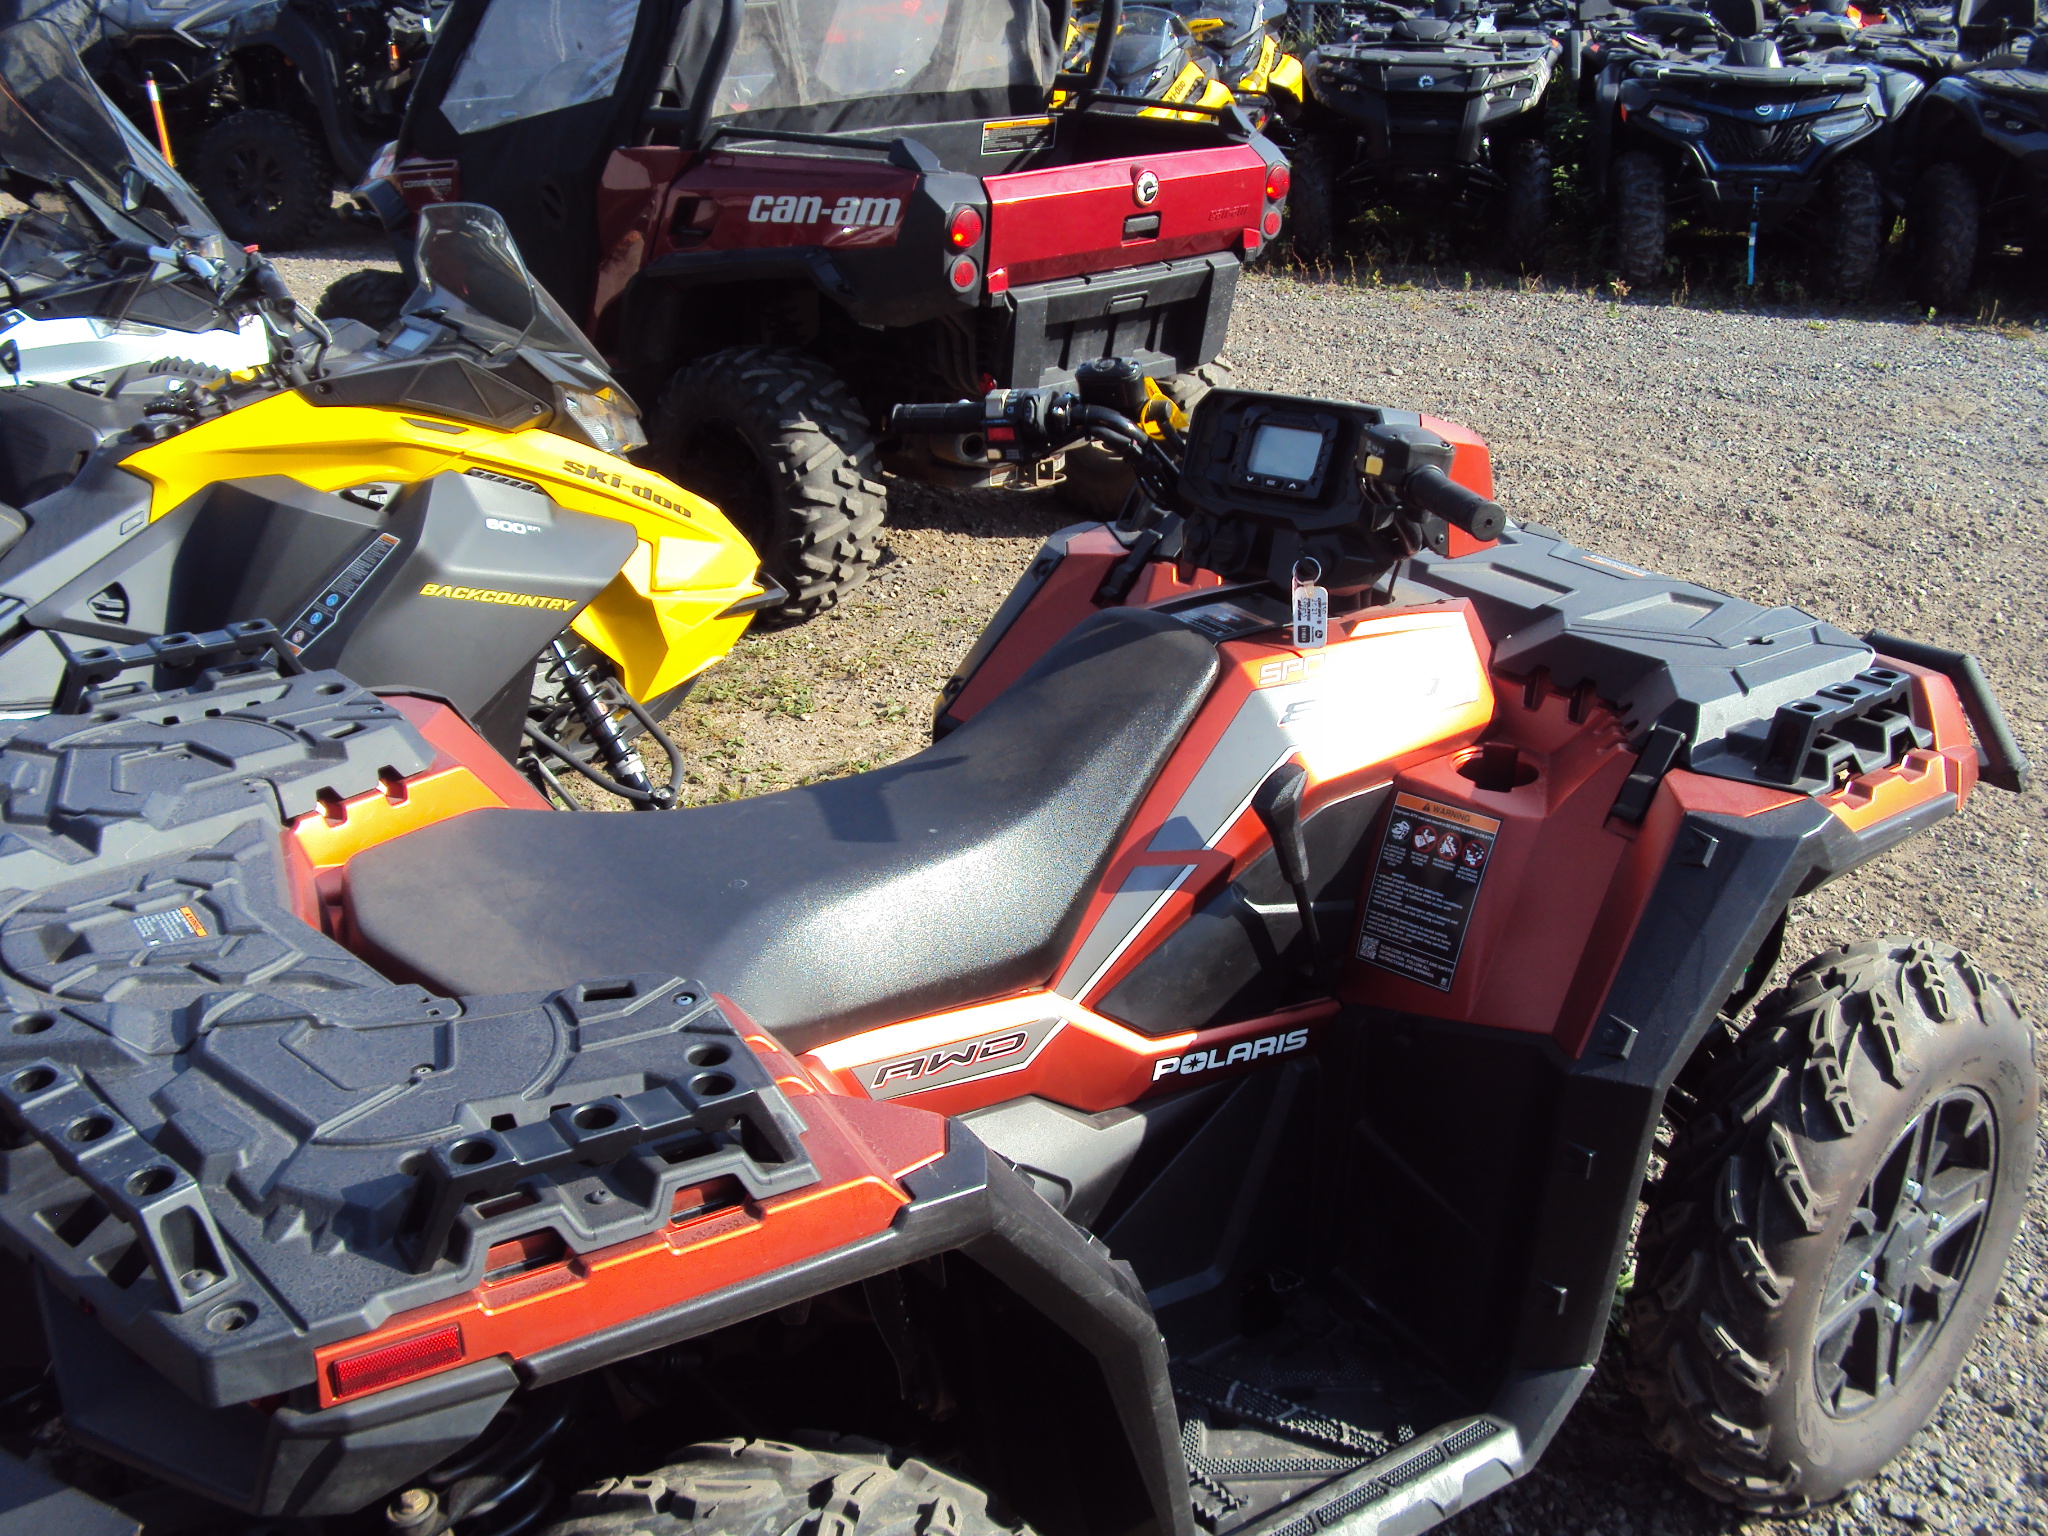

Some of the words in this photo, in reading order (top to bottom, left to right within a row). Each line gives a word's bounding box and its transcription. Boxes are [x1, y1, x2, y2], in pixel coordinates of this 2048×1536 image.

[748, 195, 902, 227] can-am
[562, 460, 692, 518] ski-doo
[419, 582, 577, 612] BACKCOUNTRY
[1433, 805, 1470, 822] WARNING
[870, 1030, 1029, 1089] AWD
[1152, 1028, 1309, 1081] POLARIS
